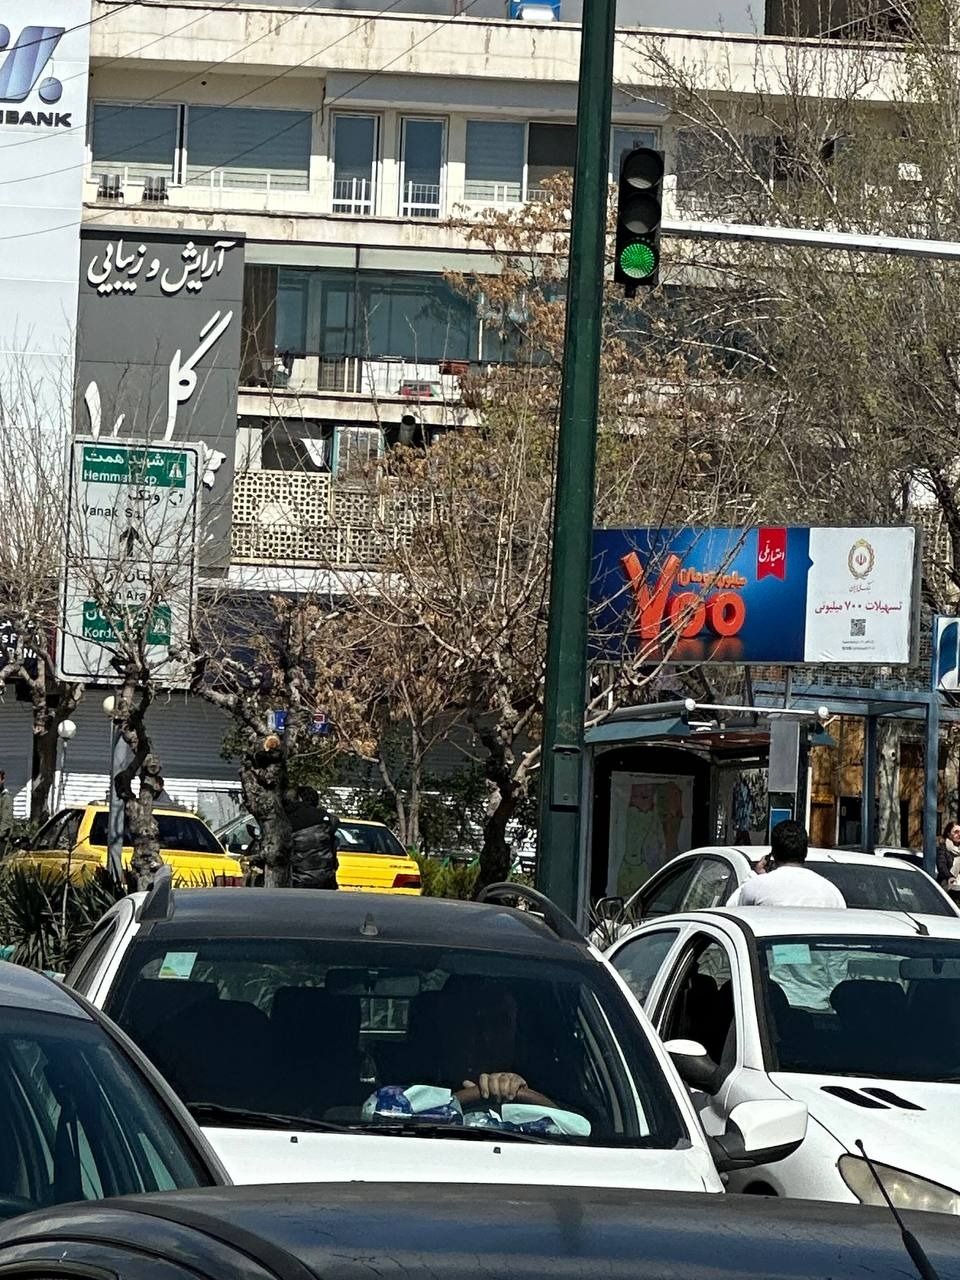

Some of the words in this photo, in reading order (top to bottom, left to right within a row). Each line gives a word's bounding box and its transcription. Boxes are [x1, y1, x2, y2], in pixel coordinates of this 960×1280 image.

[87, 238, 147, 296] زیبایی
[145, 257, 161, 281] و
[160, 240, 237, 294] آرایش
[85, 451, 125, 465] همت
[82, 504, 119, 518] Vanak
[844, 601, 862, 611] ۷۰۰
[865, 601, 903, 614] تسهیلات
